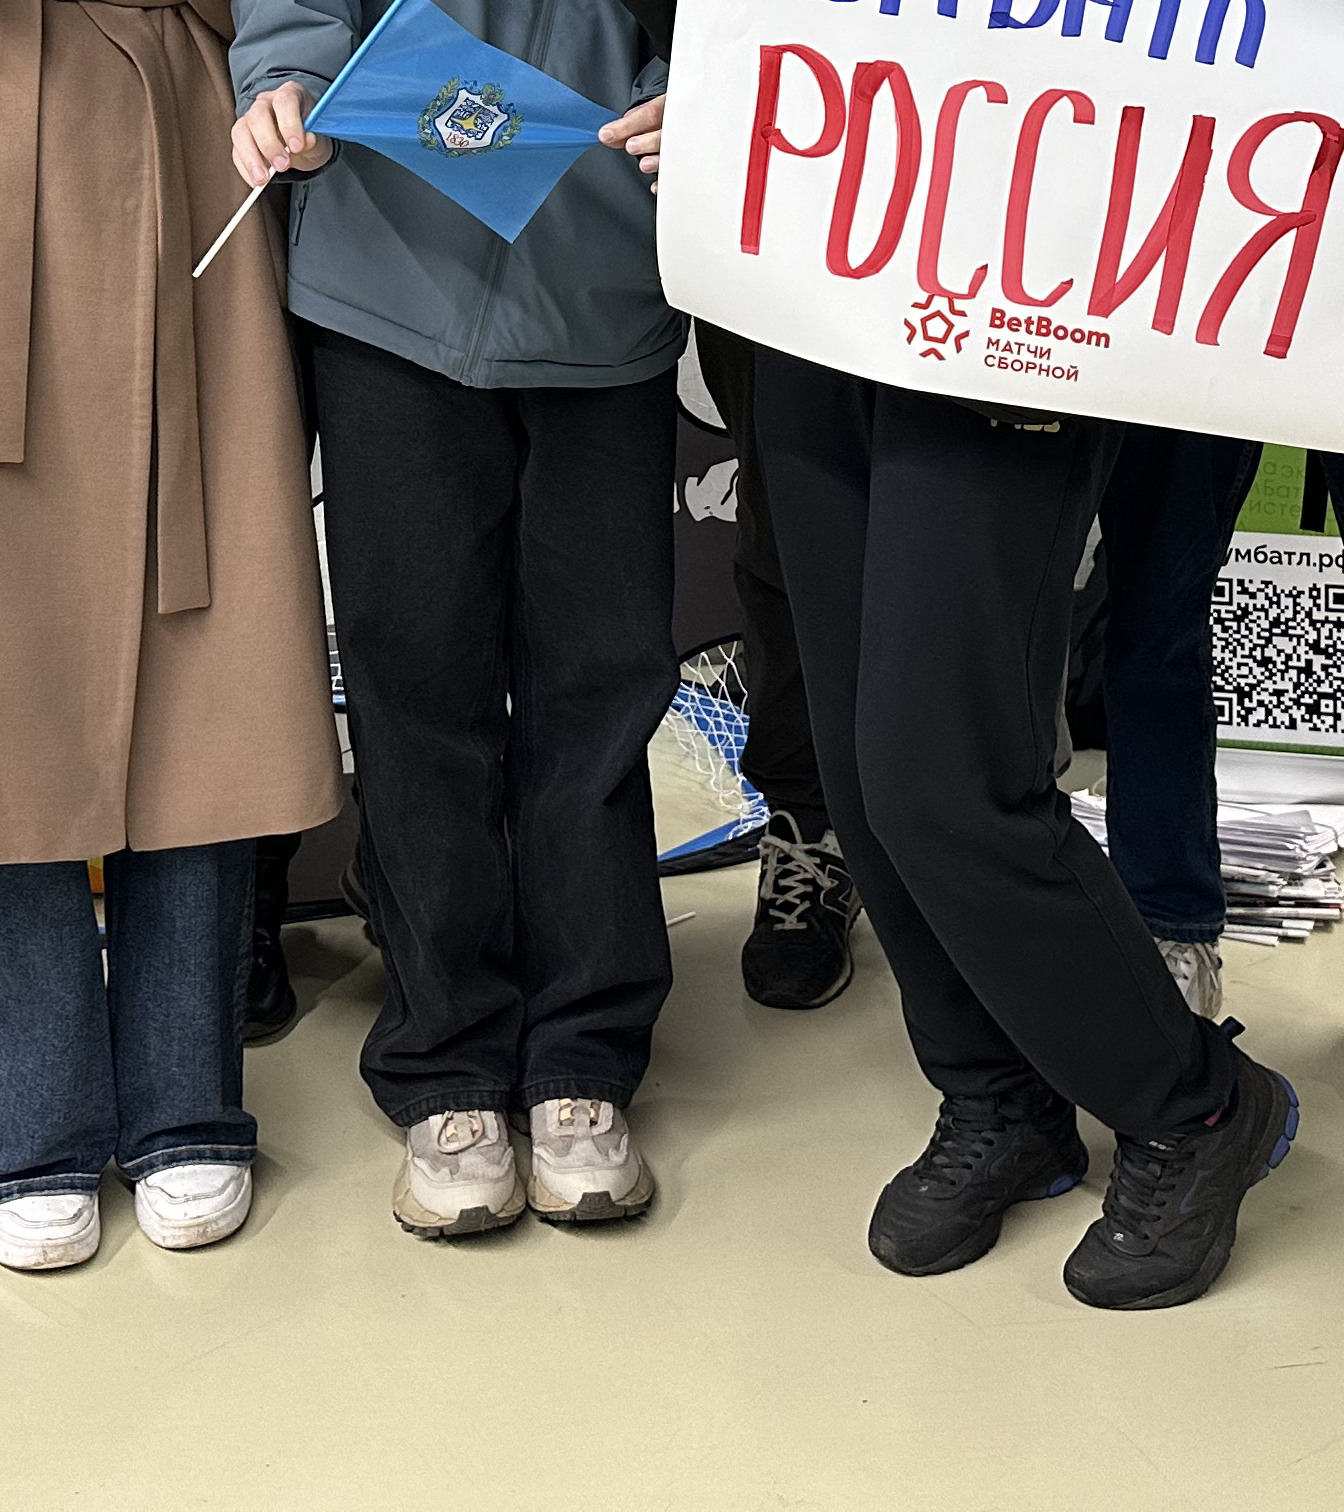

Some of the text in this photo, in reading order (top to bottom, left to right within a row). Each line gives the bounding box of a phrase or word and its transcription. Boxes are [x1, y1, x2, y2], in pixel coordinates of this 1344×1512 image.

[989, 307, 1111, 349] BetBoom
[986, 337, 1052, 360] МАТЧИ
[984, 354, 1080, 382] СБОРНОЙ
